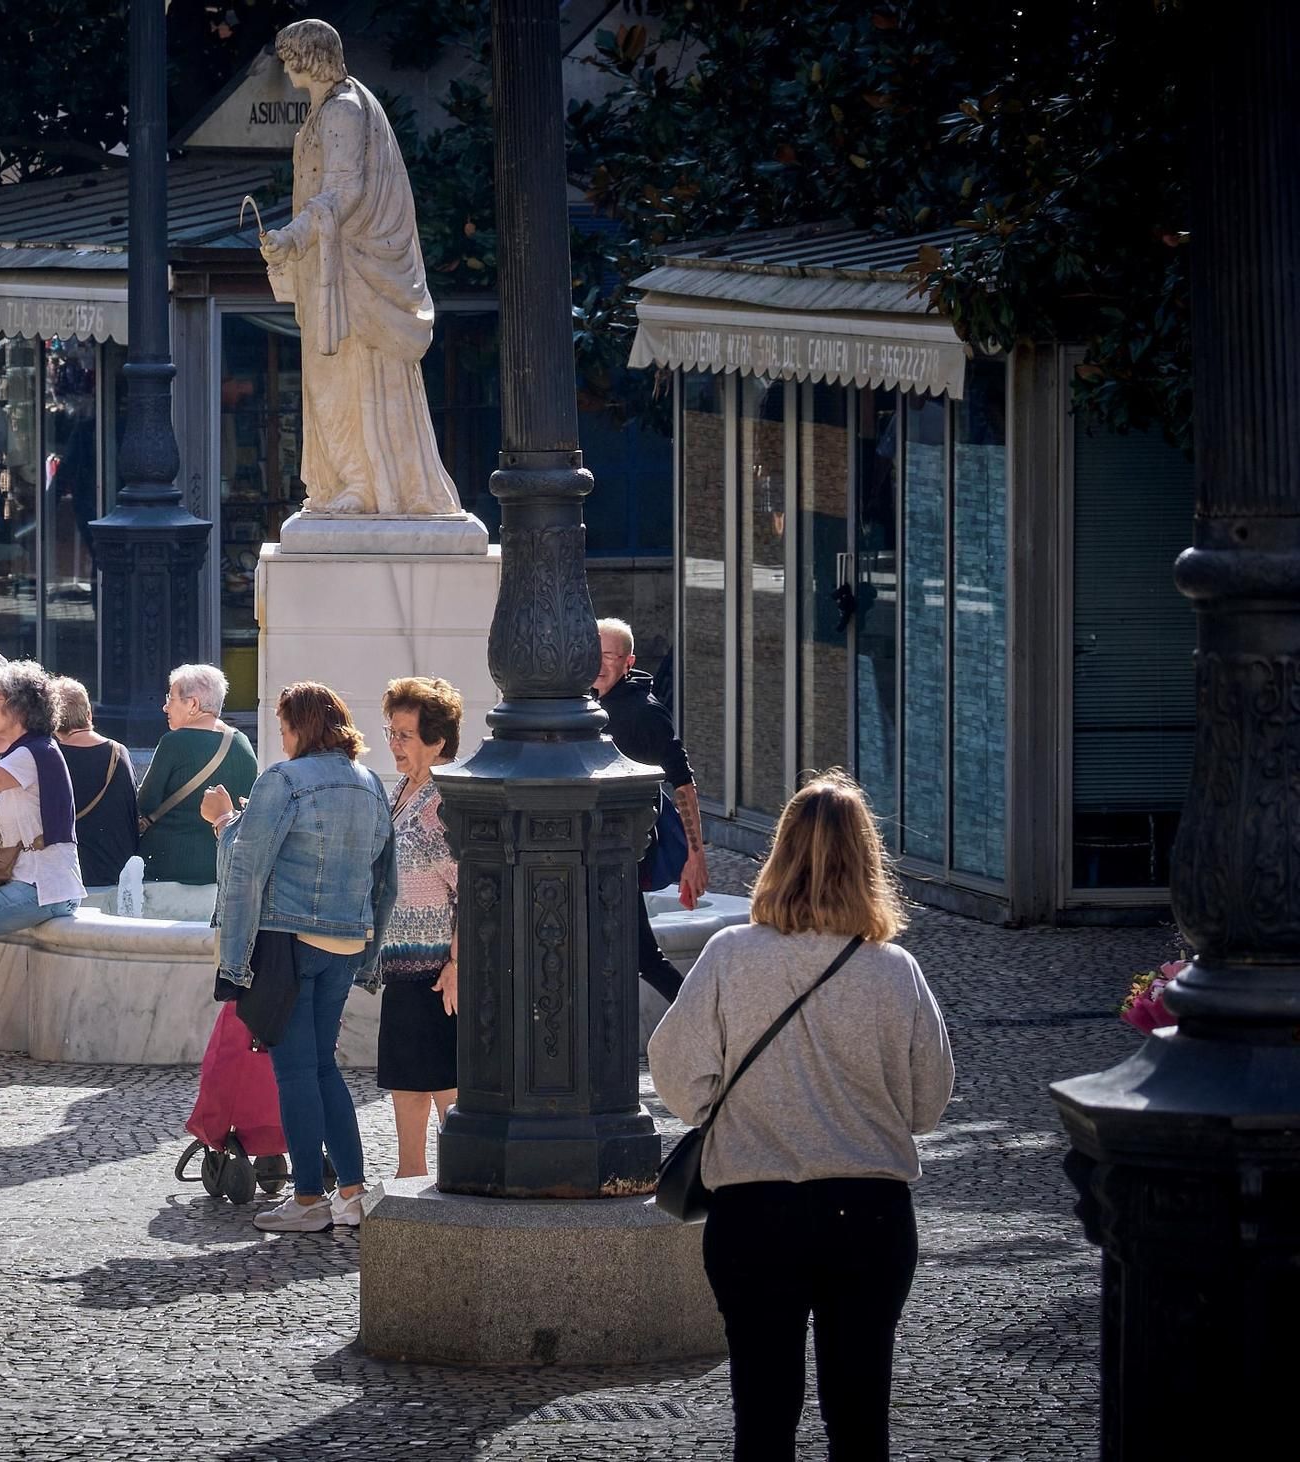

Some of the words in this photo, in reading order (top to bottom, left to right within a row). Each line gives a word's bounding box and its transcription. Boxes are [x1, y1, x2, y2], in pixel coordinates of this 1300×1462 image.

[249, 101, 311, 124] ASUNCIO
[783, 335, 801, 369] DEL
[808, 338, 848, 372] CARMEN
